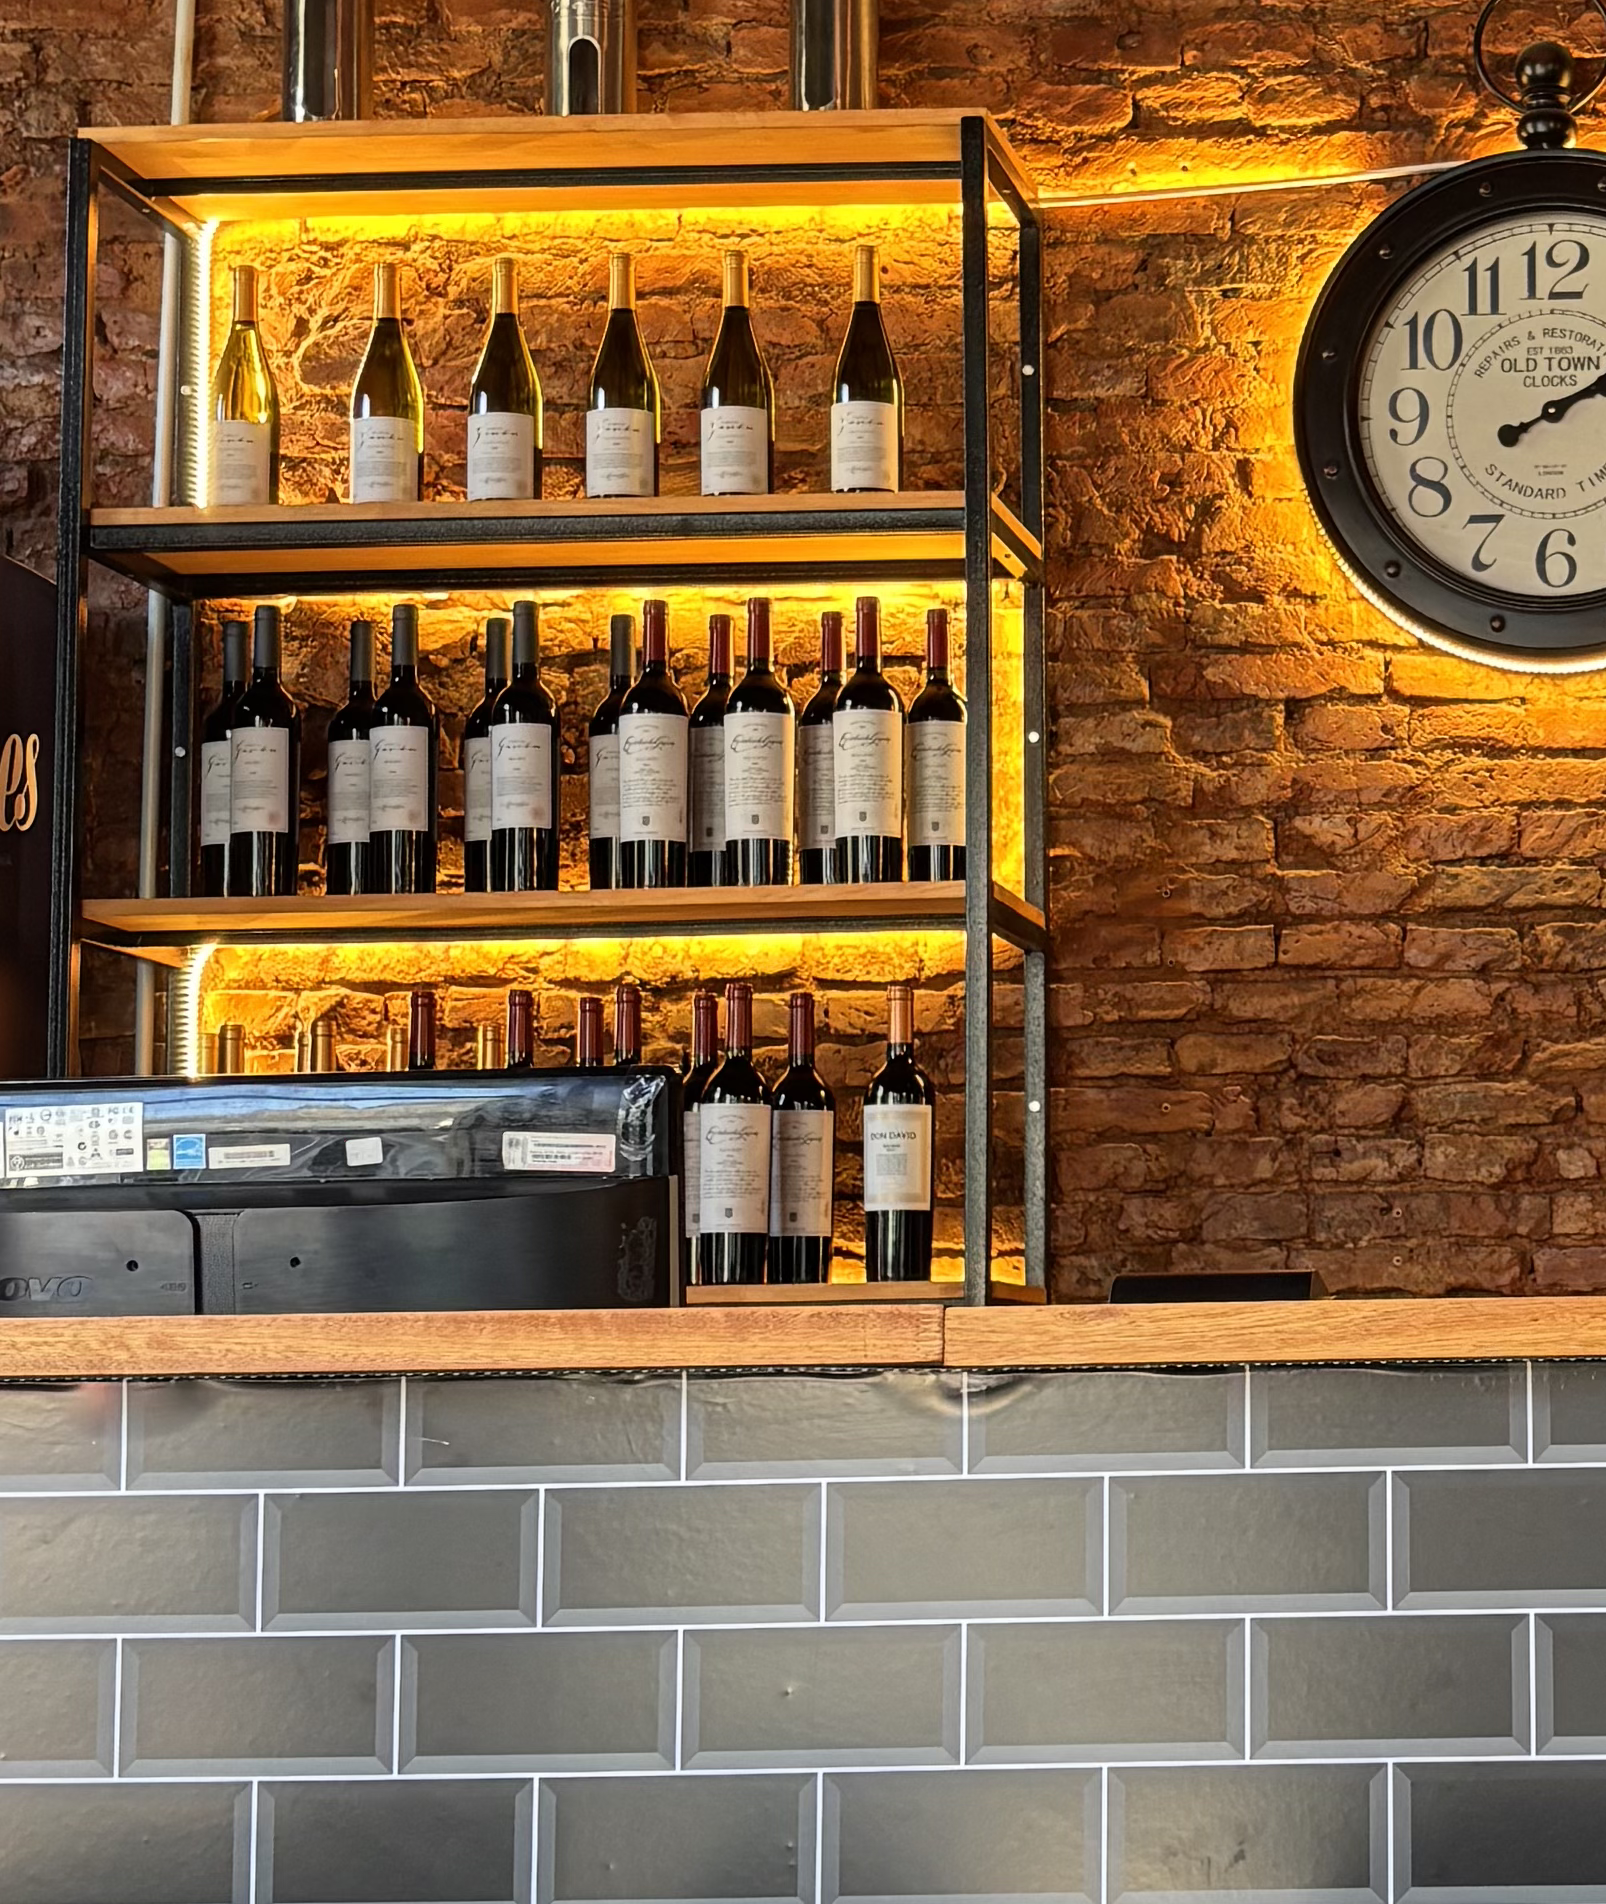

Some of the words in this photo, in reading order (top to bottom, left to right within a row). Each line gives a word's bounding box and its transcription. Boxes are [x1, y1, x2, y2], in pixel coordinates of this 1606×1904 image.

[1460, 257, 1507, 316] 11
[1520, 239, 1590, 300] 12
[1400, 308, 1463, 371] 10
[1474, 336, 1520, 378] REPAIRS
[1527, 330, 1535, 341] &
[1501, 357, 1538, 373] OLD
[1543, 356, 1600, 372] TOWN
[1527, 346, 1544, 356] EST
[1523, 375, 1578, 388] CLOCKS
[1388, 387, 1430, 446] 9
[1408, 456, 1452, 518] 8
[1485, 463, 1566, 500] STANDARD
[1461, 514, 1506, 572] 7
[1535, 528, 1577, 588] 6
[889, 1131, 917, 1141] DAVID
